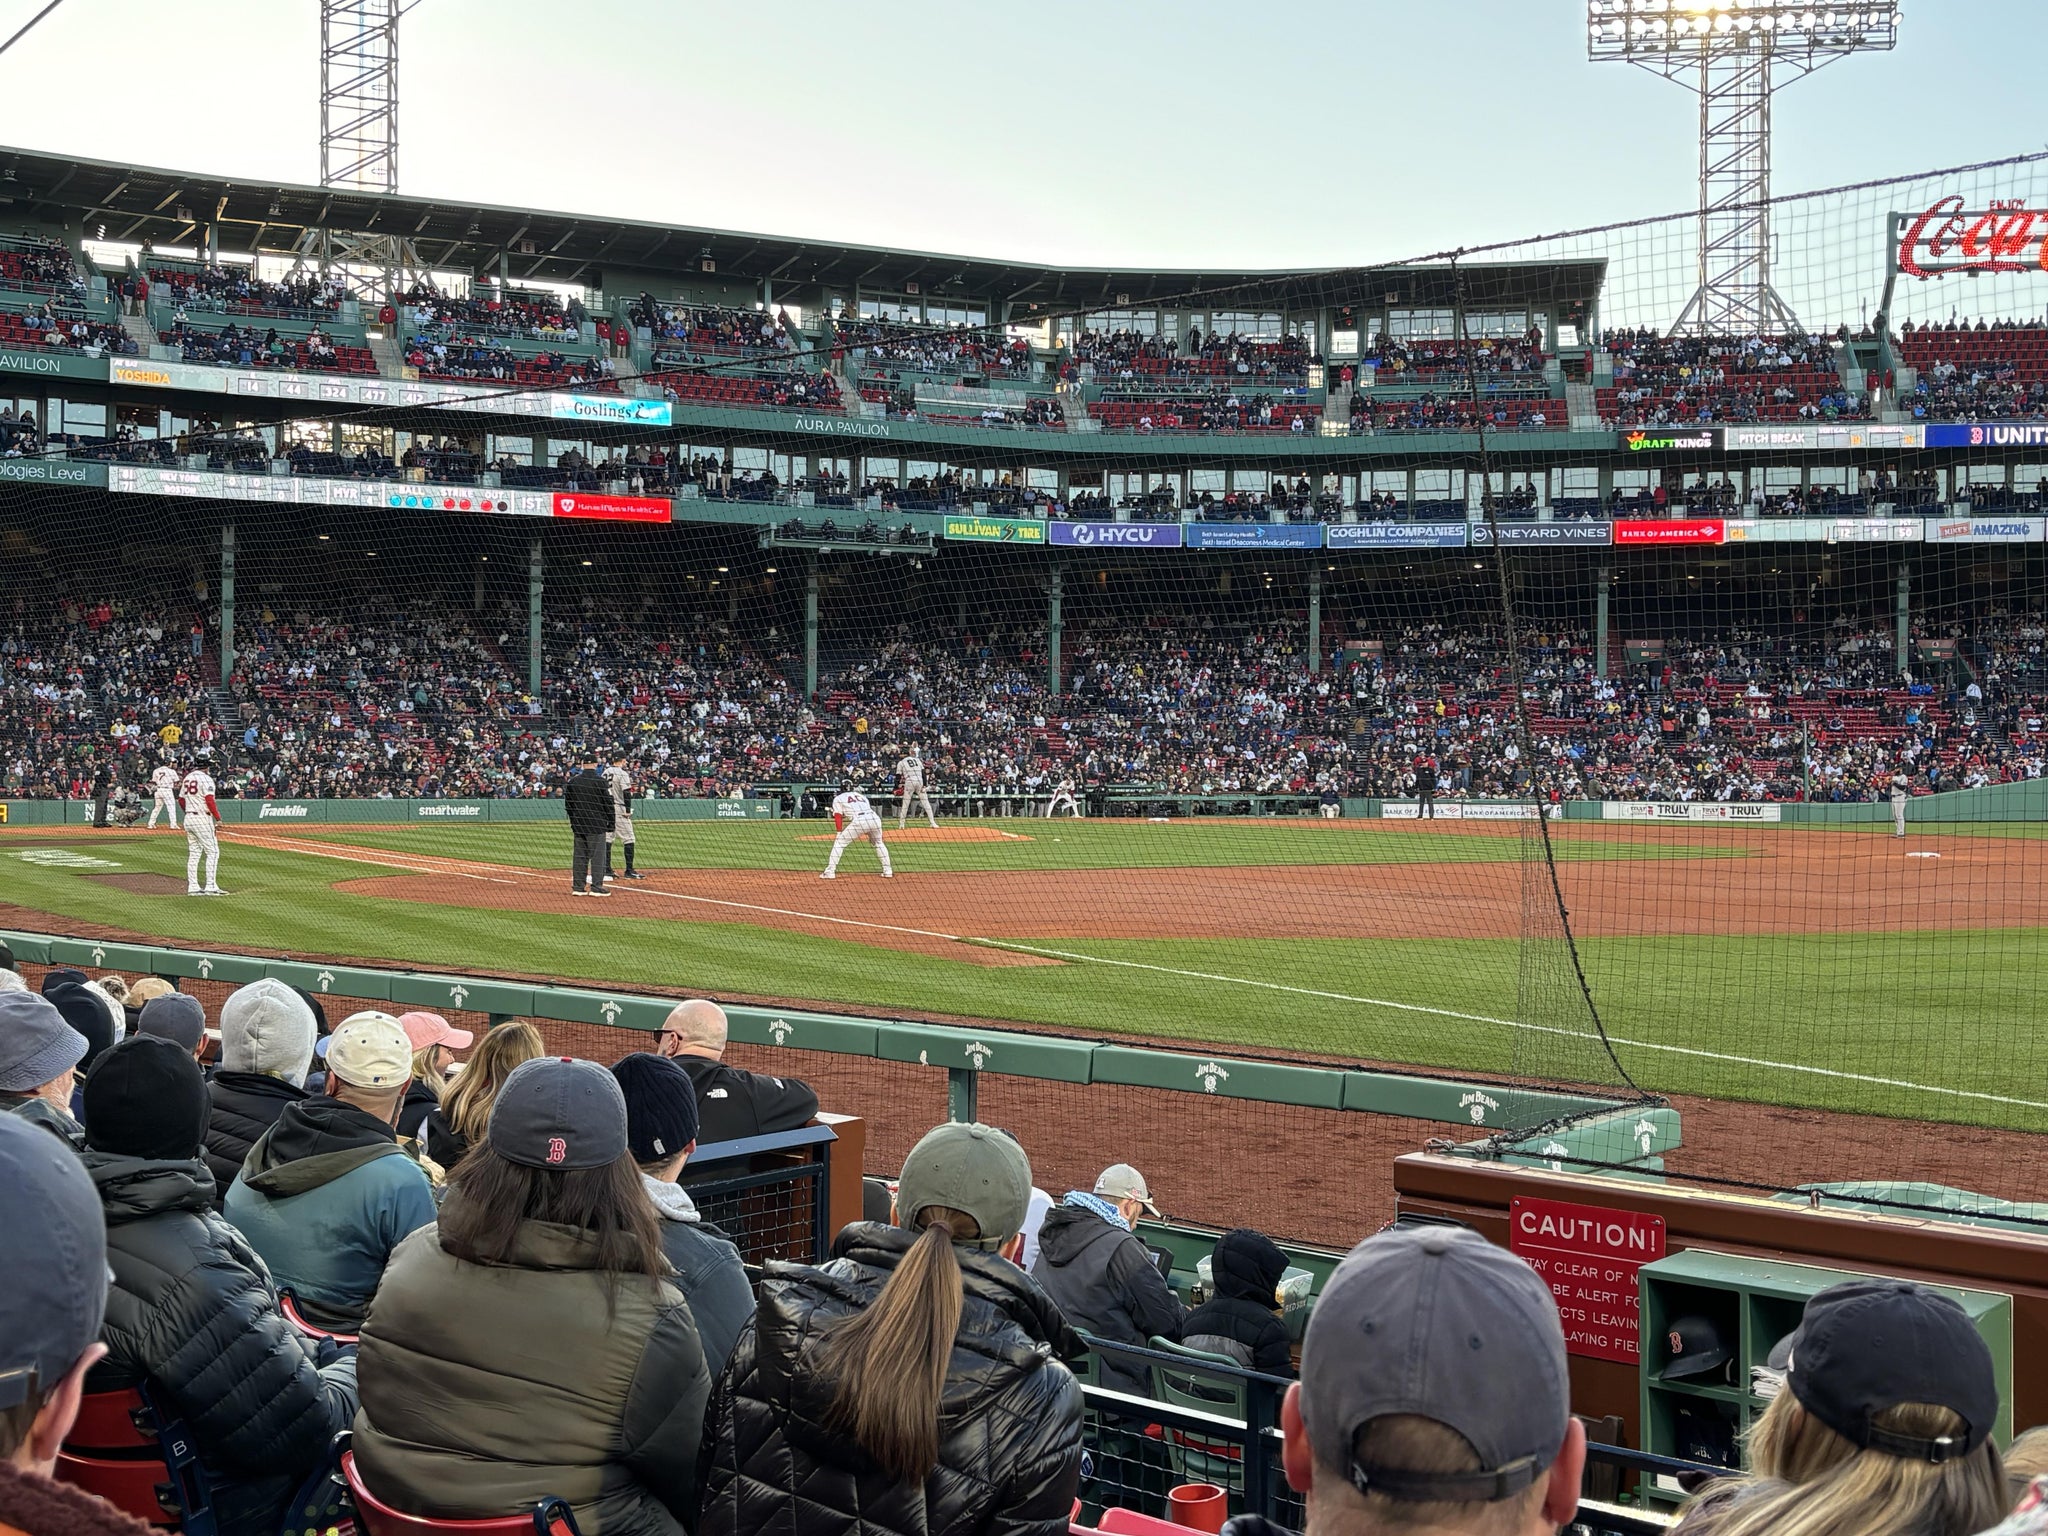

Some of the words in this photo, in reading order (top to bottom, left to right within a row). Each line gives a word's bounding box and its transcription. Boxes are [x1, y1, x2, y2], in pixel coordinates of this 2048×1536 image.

[1990, 198, 2027, 211] ENJOY
[1899, 195, 2048, 277] Coca
[1119, 294, 1127, 303] 12
[116, 369, 171, 385] YOSHIDA
[247, 381, 259, 392] 14
[287, 385, 301, 395] 44
[322, 387, 346, 398] .324
[362, 390, 385, 401] .477
[403, 393, 423, 404] .412
[574, 402, 632, 421] Goslings
[795, 419, 834, 432] AURA
[837, 421, 890, 437] PAVILION
[1630, 437, 1712, 450] DRAFTKINGS
[1739, 434, 1767, 444] PITCH
[1770, 434, 1804, 444] BREAK
[50, 465, 86, 481] Level
[164, 484, 196, 495] BOSTON
[399, 485, 424, 495] BALL
[442, 488, 473, 499] STRIKE
[485, 490, 504, 500] OUT
[949, 523, 1001, 538] SULLIVAN
[1018, 527, 1041, 539] TIRE
[1100, 528, 1153, 542] HYCU
[1331, 527, 1386, 539] COGHLIN
[1387, 526, 1465, 538] COMPANIES
[1487, 529, 1561, 540] VINEYARD
[1563, 528, 1608, 539] VINES
[1622, 530, 1645, 538] BANK
[1647, 530, 1657, 538] OF
[1659, 530, 1698, 538] AMERICA
[1730, 528, 1748, 539] GIL
[1841, 528, 1851, 538] 12
[1899, 528, 1913, 538] 50
[1973, 523, 2031, 536] AMAZING
[1263, 539, 1285, 547] Medical
[1285, 539, 1305, 547] Center
[907, 759, 918, 768] 81
[159, 772, 166, 781] 7
[184, 780, 198, 795] 58
[259, 803, 308, 819] Franklin
[419, 804, 481, 817] smartwater
[718, 802, 733, 812] city
[1657, 805, 1690, 815] TRULY
[1729, 806, 1762, 816] TRULY
[768, 1021, 778, 1034] JIM
[778, 1018, 792, 1036] BEAM
[964, 1042, 976, 1056] JIM
[976, 1041, 991, 1059] BEAM
[1195, 1063, 1209, 1078] JIM
[1209, 1061, 1227, 1081] BEAM
[1458, 1092, 1475, 1109] JIM
[1475, 1090, 1497, 1112] BEAM
[546, 1138, 567, 1164] B
[1519, 1211, 1656, 1253] CAUTION!
[1554, 1261, 1598, 1280] CLEAR
[1604, 1269, 1624, 1282] OF
[1553, 1283, 1570, 1298] BE
[1576, 1287, 1619, 1305] ALERT
[1625, 1296, 1640, 1309] FO
[1593, 1311, 1640, 1330] LEAVIN
[1562, 1332, 1608, 1348] LAYING
[1614, 1338, 1640, 1354] FIEL
[1669, 1332, 1682, 1354] B
[172, 1440, 187, 1457] B
